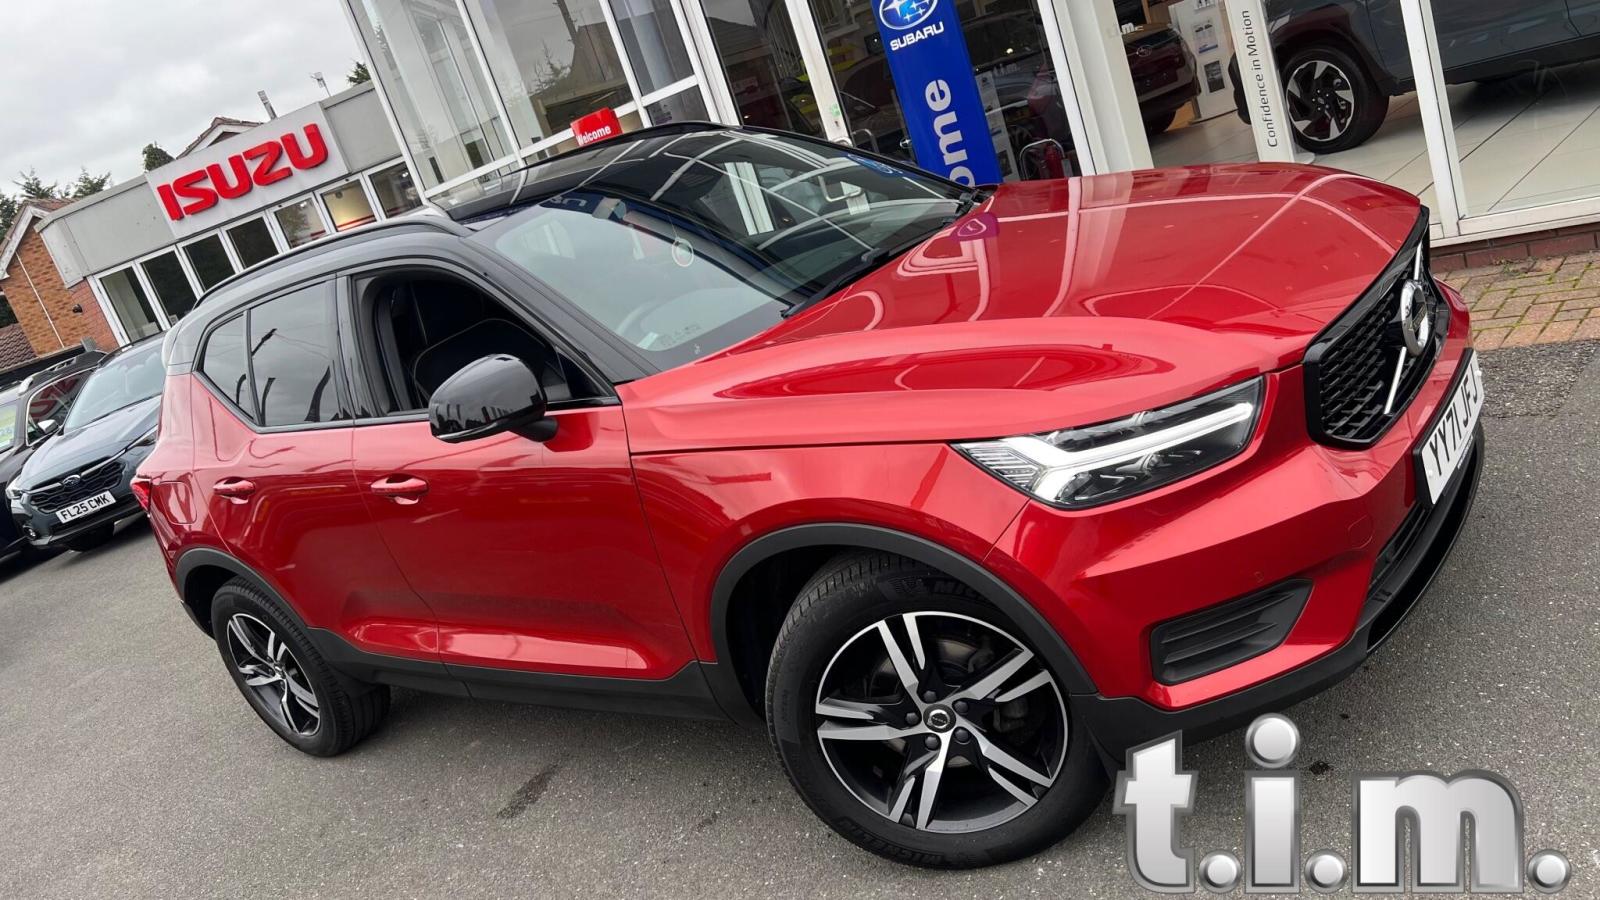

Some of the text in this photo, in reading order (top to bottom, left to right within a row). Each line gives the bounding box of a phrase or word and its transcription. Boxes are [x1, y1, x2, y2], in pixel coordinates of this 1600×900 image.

[890, 21, 944, 51] SUBARU
[1241, 10, 1278, 148] Confidence in Motion
[576, 126, 612, 146] Welcome
[157, 123, 328, 221] ISUZU
[1429, 402, 1462, 476] YY71
[1461, 363, 1478, 429] JFJ
[60, 494, 110, 520] FL25 CMK
